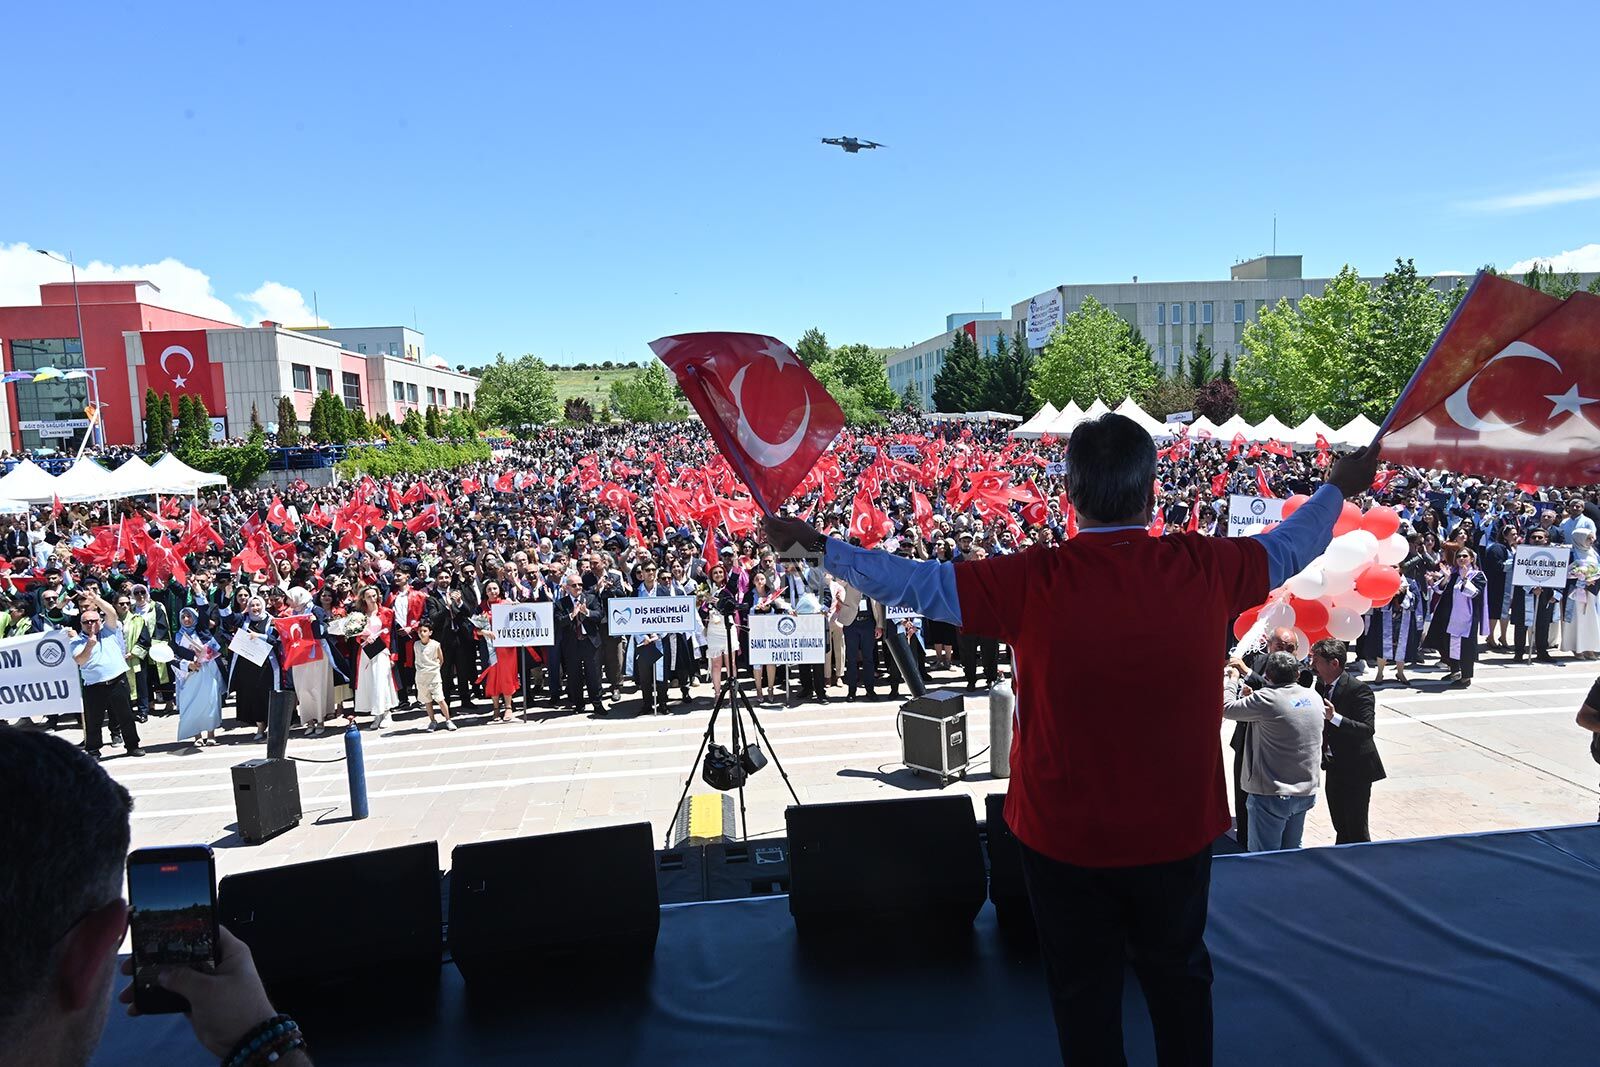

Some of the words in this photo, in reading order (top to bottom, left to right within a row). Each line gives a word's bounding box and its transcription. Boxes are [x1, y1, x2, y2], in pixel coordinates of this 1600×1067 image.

[1517, 558, 1538, 566] SAĞLIK
[1539, 559, 1567, 568] BİLİMLERİ
[1525, 568, 1556, 577] FAKÜLTESİ
[635, 606, 648, 615] DİŞ
[649, 604, 690, 614] HEKİMLİĞİ
[508, 611, 537, 621] MESLEK
[641, 615, 684, 624] FAKÜLTESİ
[497, 627, 549, 639] YÜKSEKOKULU
[751, 639, 767, 649] SANAT
[768, 639, 790, 649] TASARIM
[791, 639, 798, 648] VE
[799, 636, 824, 648] MİMARLIK
[0, 648, 22, 669] M
[771, 649, 803, 662] FAKÜLTESİ
[0, 680, 69, 705] OKULU
